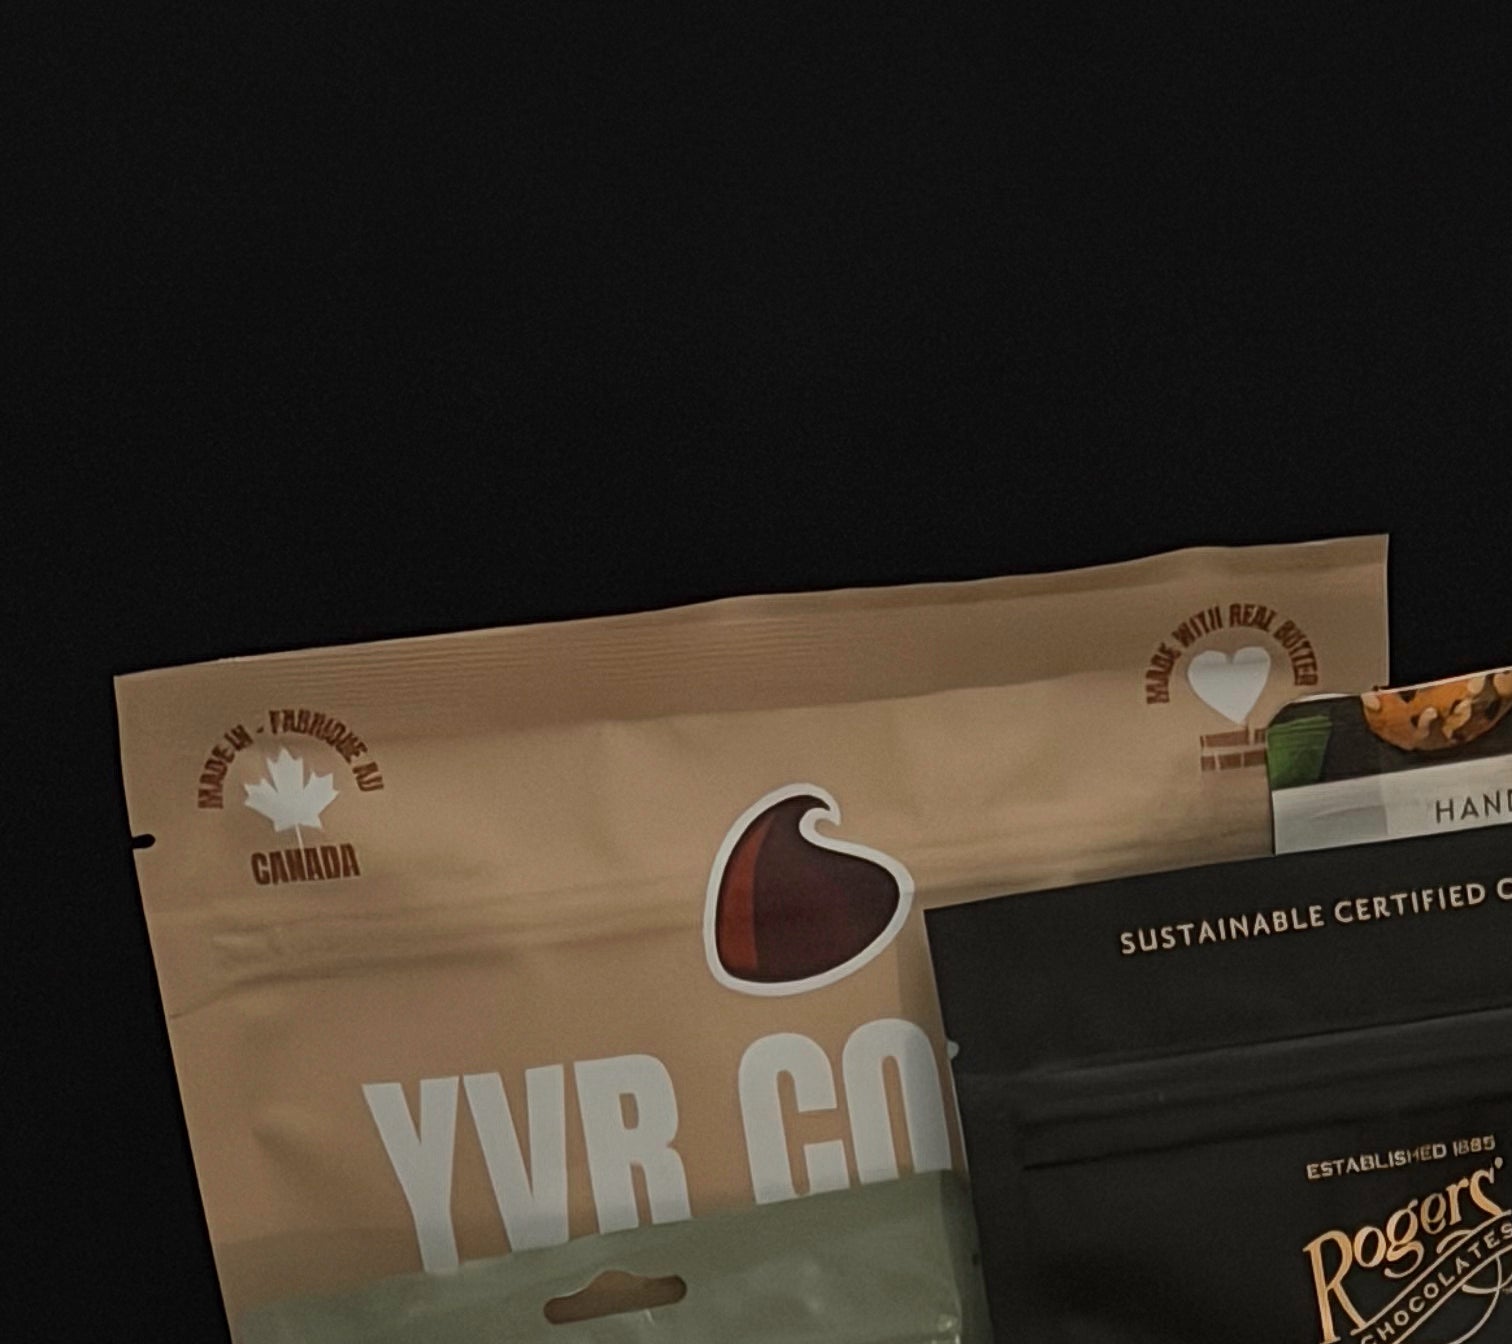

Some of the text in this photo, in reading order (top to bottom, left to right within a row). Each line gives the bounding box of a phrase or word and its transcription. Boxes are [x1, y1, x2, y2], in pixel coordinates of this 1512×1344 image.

[1229, 603, 1277, 631] REAL
[1274, 620, 1319, 686] BUTTER
[198, 745, 235, 809] MADE
[225, 724, 253, 751] IN
[353, 762, 384, 792] AU
[251, 843, 360, 885] CANADA
[1120, 904, 1325, 955] SUSTAINABLE
[1334, 882, 1487, 924] CERTIFIED
[362, 1053, 692, 1277] YVR
[1306, 1134, 1496, 1180] ESTABLISHED 1885
